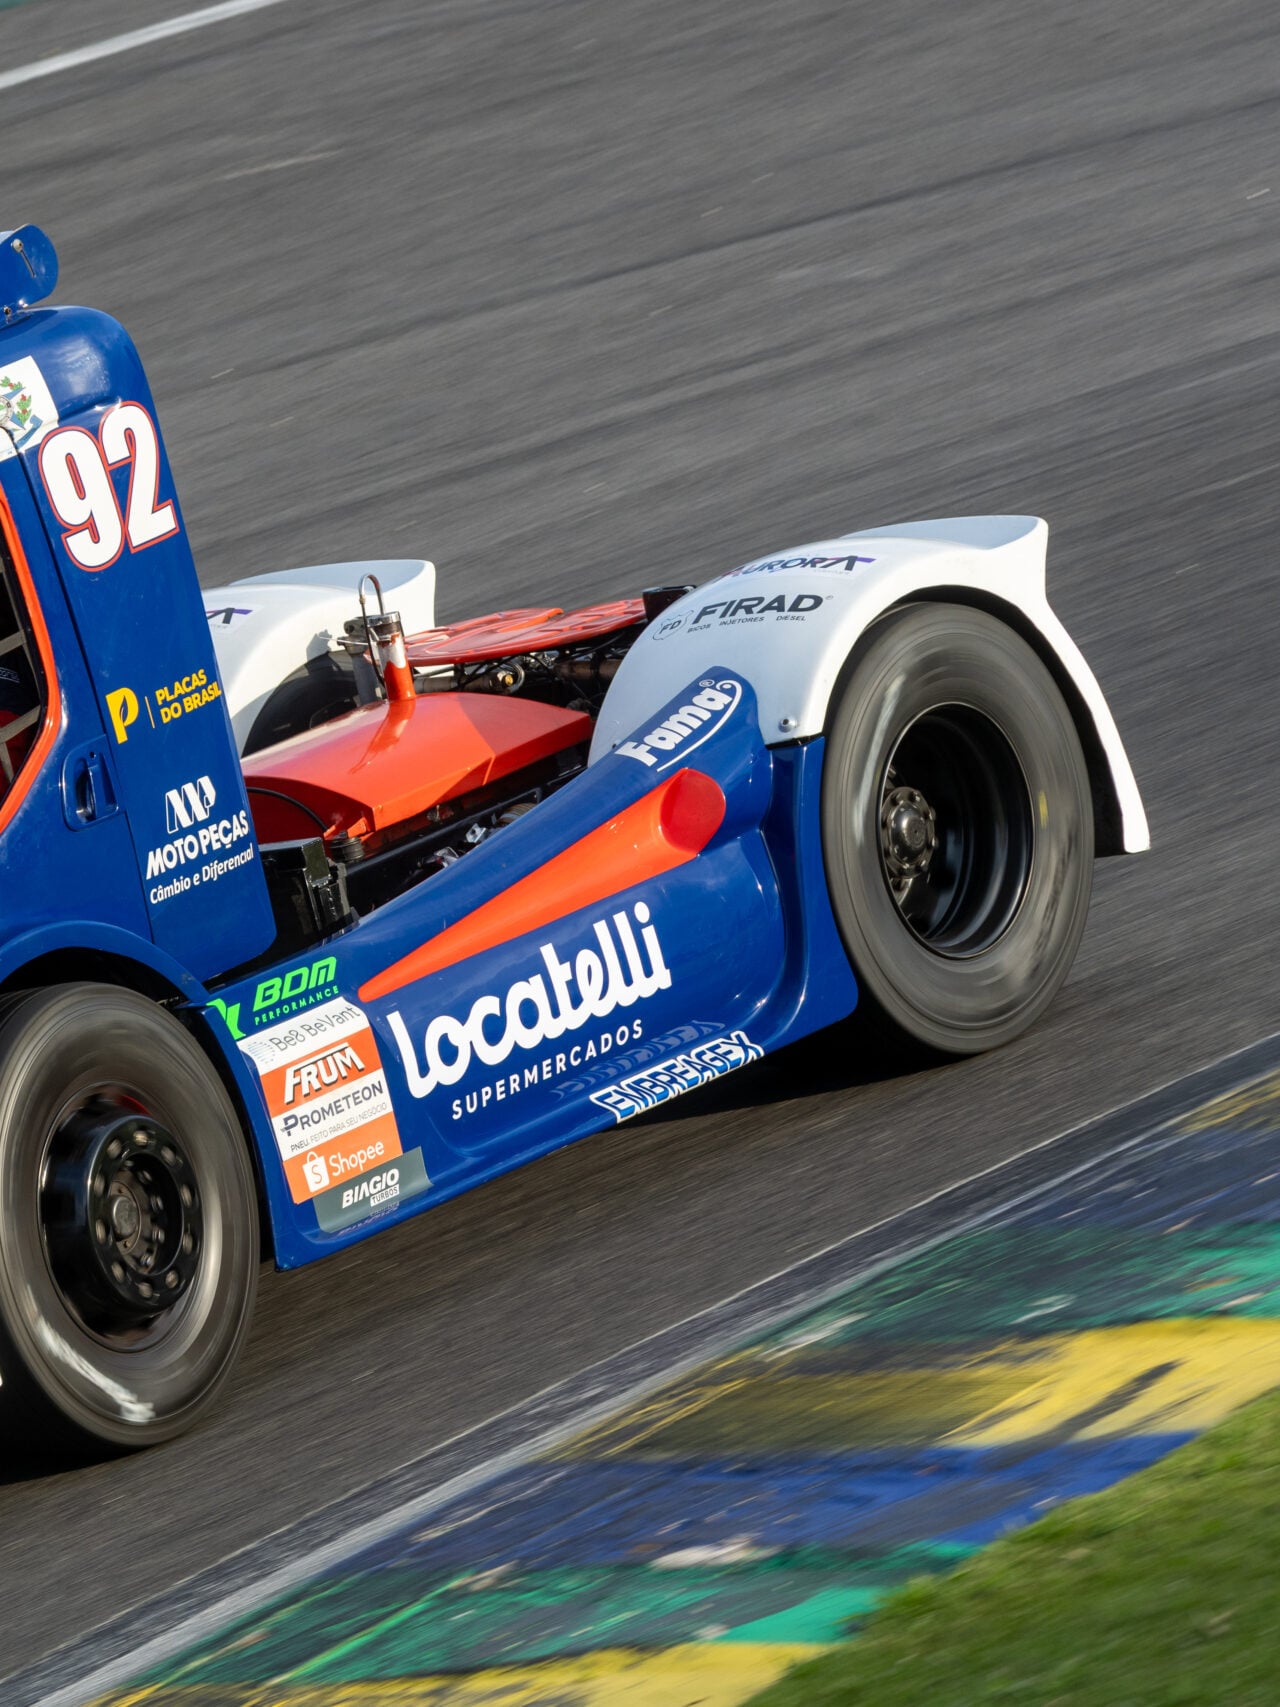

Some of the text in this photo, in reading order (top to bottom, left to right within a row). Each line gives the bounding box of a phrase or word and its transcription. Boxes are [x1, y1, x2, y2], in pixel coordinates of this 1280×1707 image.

[38, 401, 180, 572] 92
[692, 594, 823, 624] FIRAD
[719, 615, 765, 627] INJETORES
[776, 614, 807, 622] DIESEL
[155, 668, 207, 706] PLACAS
[160, 681, 222, 724] DO BRASIL
[614, 687, 733, 768] Fama
[150, 842, 254, 905] Câmbio e Diferencial
[253, 956, 337, 1012] BDM
[255, 985, 339, 1026] PERFORMANCE
[269, 1006, 361, 1053] Be8 BeVant
[284, 1041, 366, 1105] FRUM
[452, 1019, 644, 1121] SUPERMERCADOS
[589, 1030, 766, 1124] EMBREAGEX
[280, 1080, 385, 1137] PROMETEON
[329, 1122, 346, 1135] PARA
[329, 1141, 385, 1177] Shopee
[342, 1168, 400, 1209] BIAGIO
[372, 1186, 399, 1205] TURBOS
